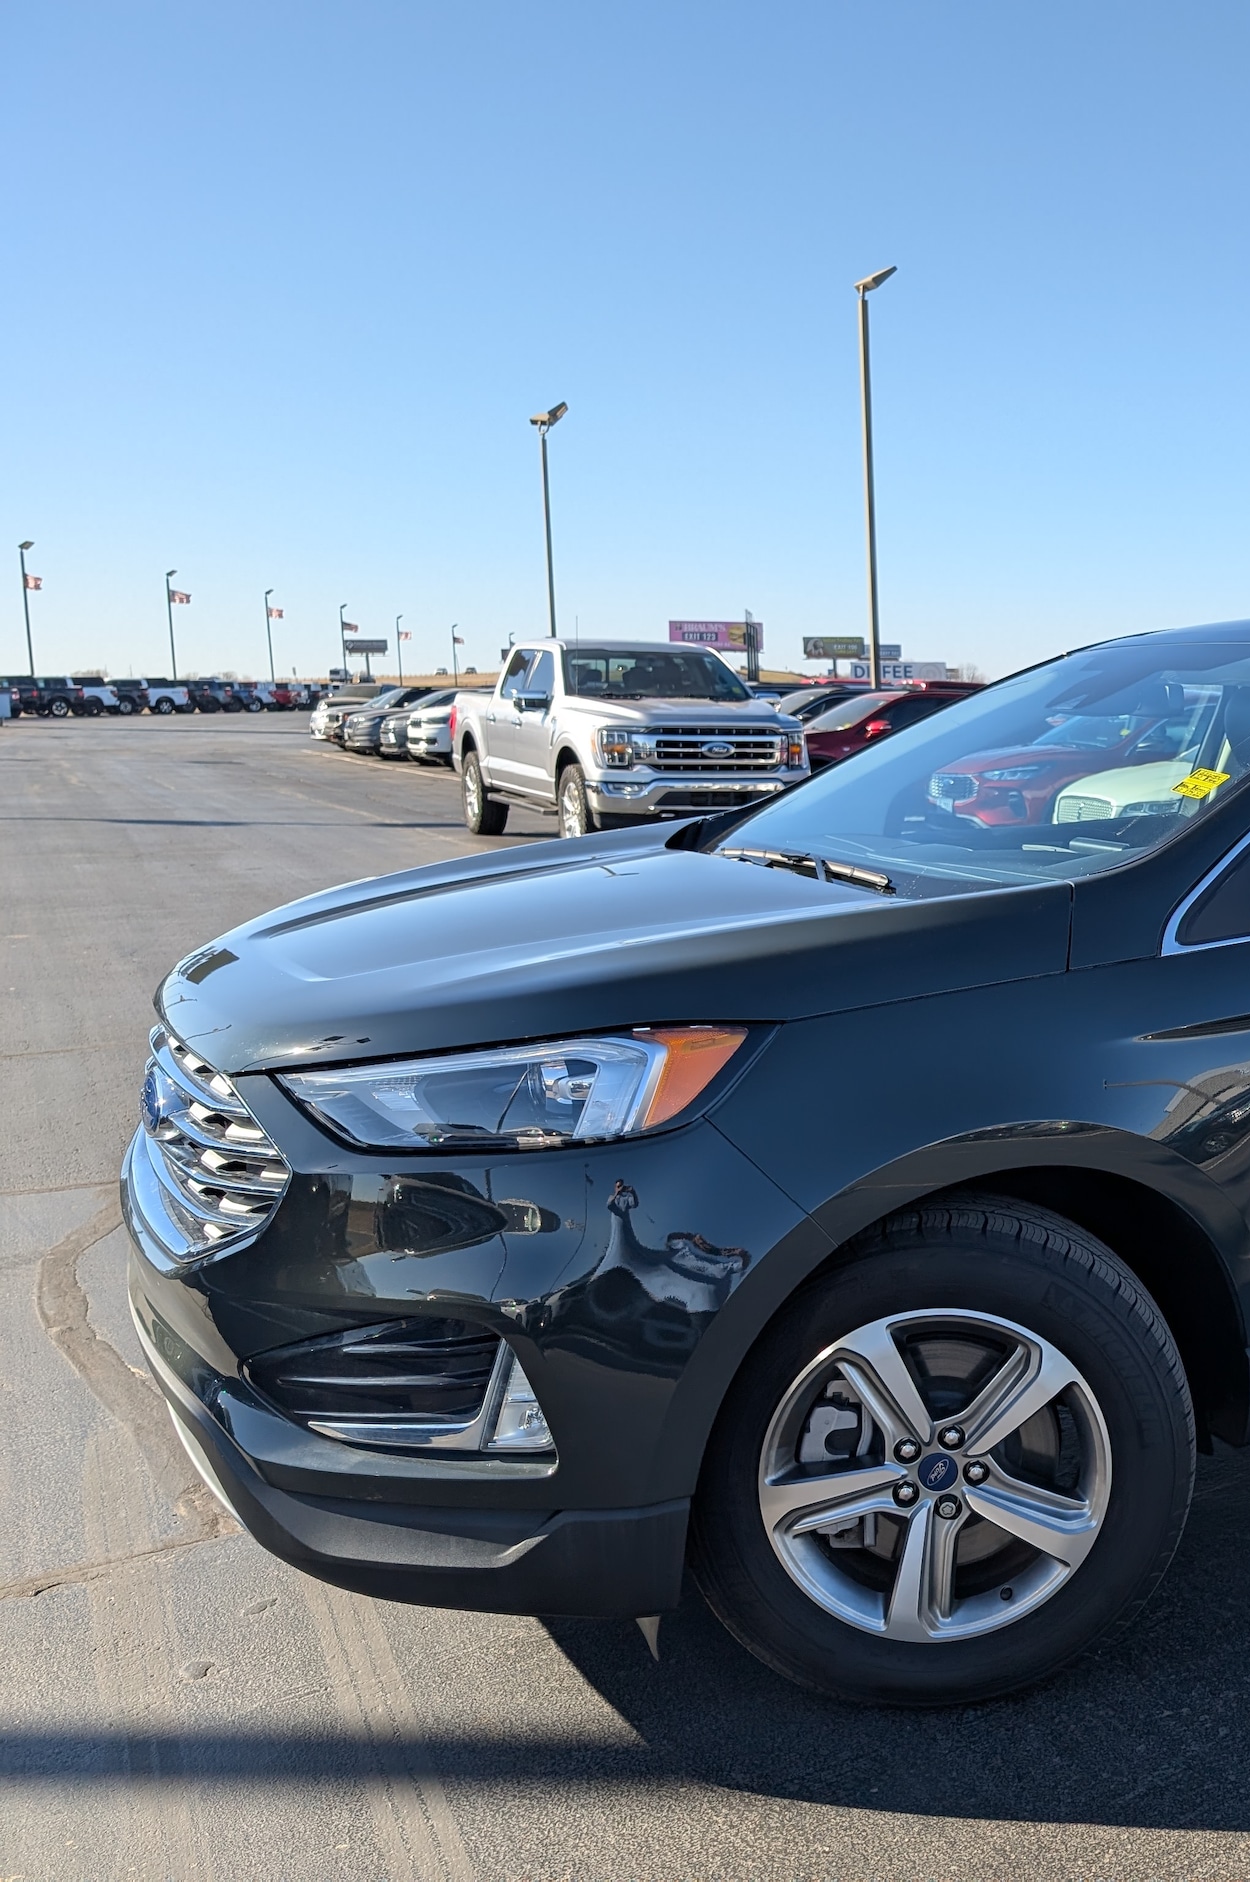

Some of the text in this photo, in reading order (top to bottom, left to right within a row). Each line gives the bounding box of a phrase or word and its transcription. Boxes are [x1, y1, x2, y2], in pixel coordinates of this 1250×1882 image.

[684, 623, 726, 632] BRAUM'S
[684, 633, 716, 641] EXIT 123
[854, 665, 913, 679] DIFEE
[929, 1463, 946, 1483] Ford
